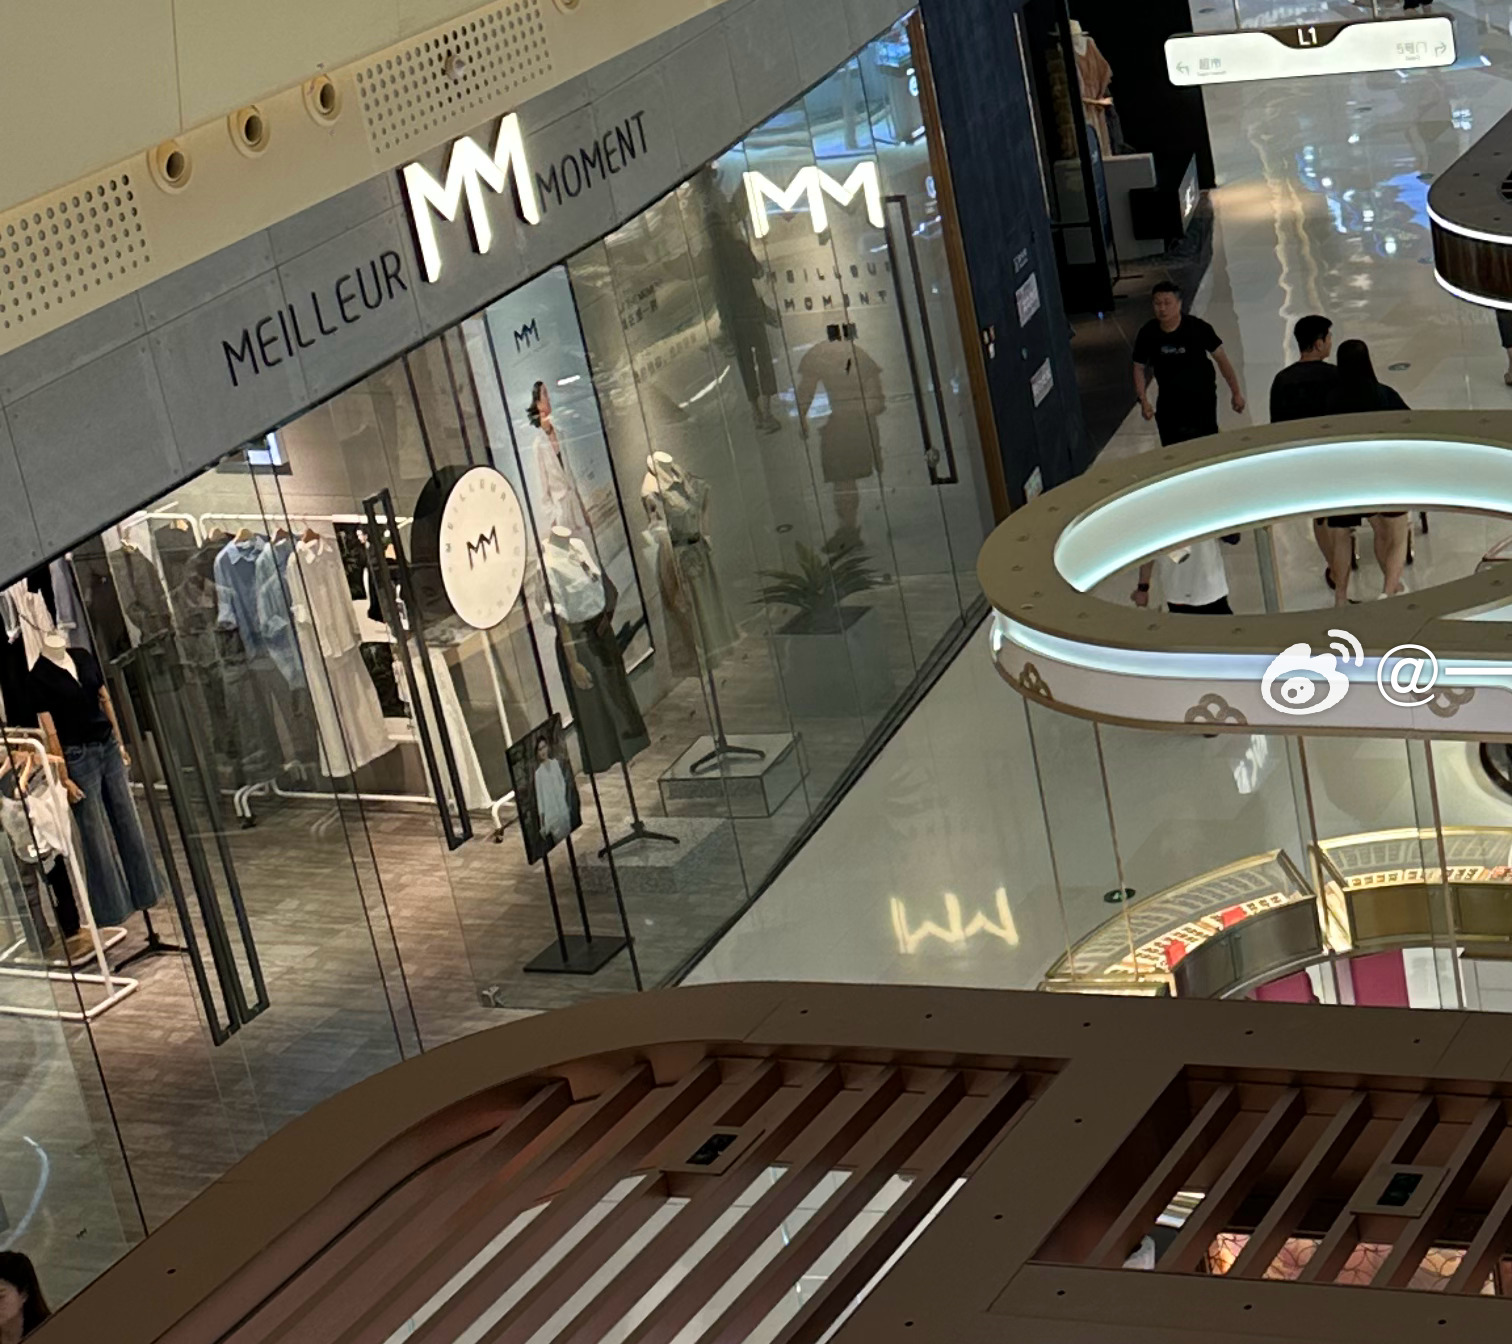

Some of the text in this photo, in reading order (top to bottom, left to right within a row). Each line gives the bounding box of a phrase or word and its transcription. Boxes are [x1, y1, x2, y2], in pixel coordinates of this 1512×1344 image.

[1297, 27, 1319, 47] L1
[222, 249, 408, 387] MEILLEUR
[535, 110, 650, 214] MOMENT
